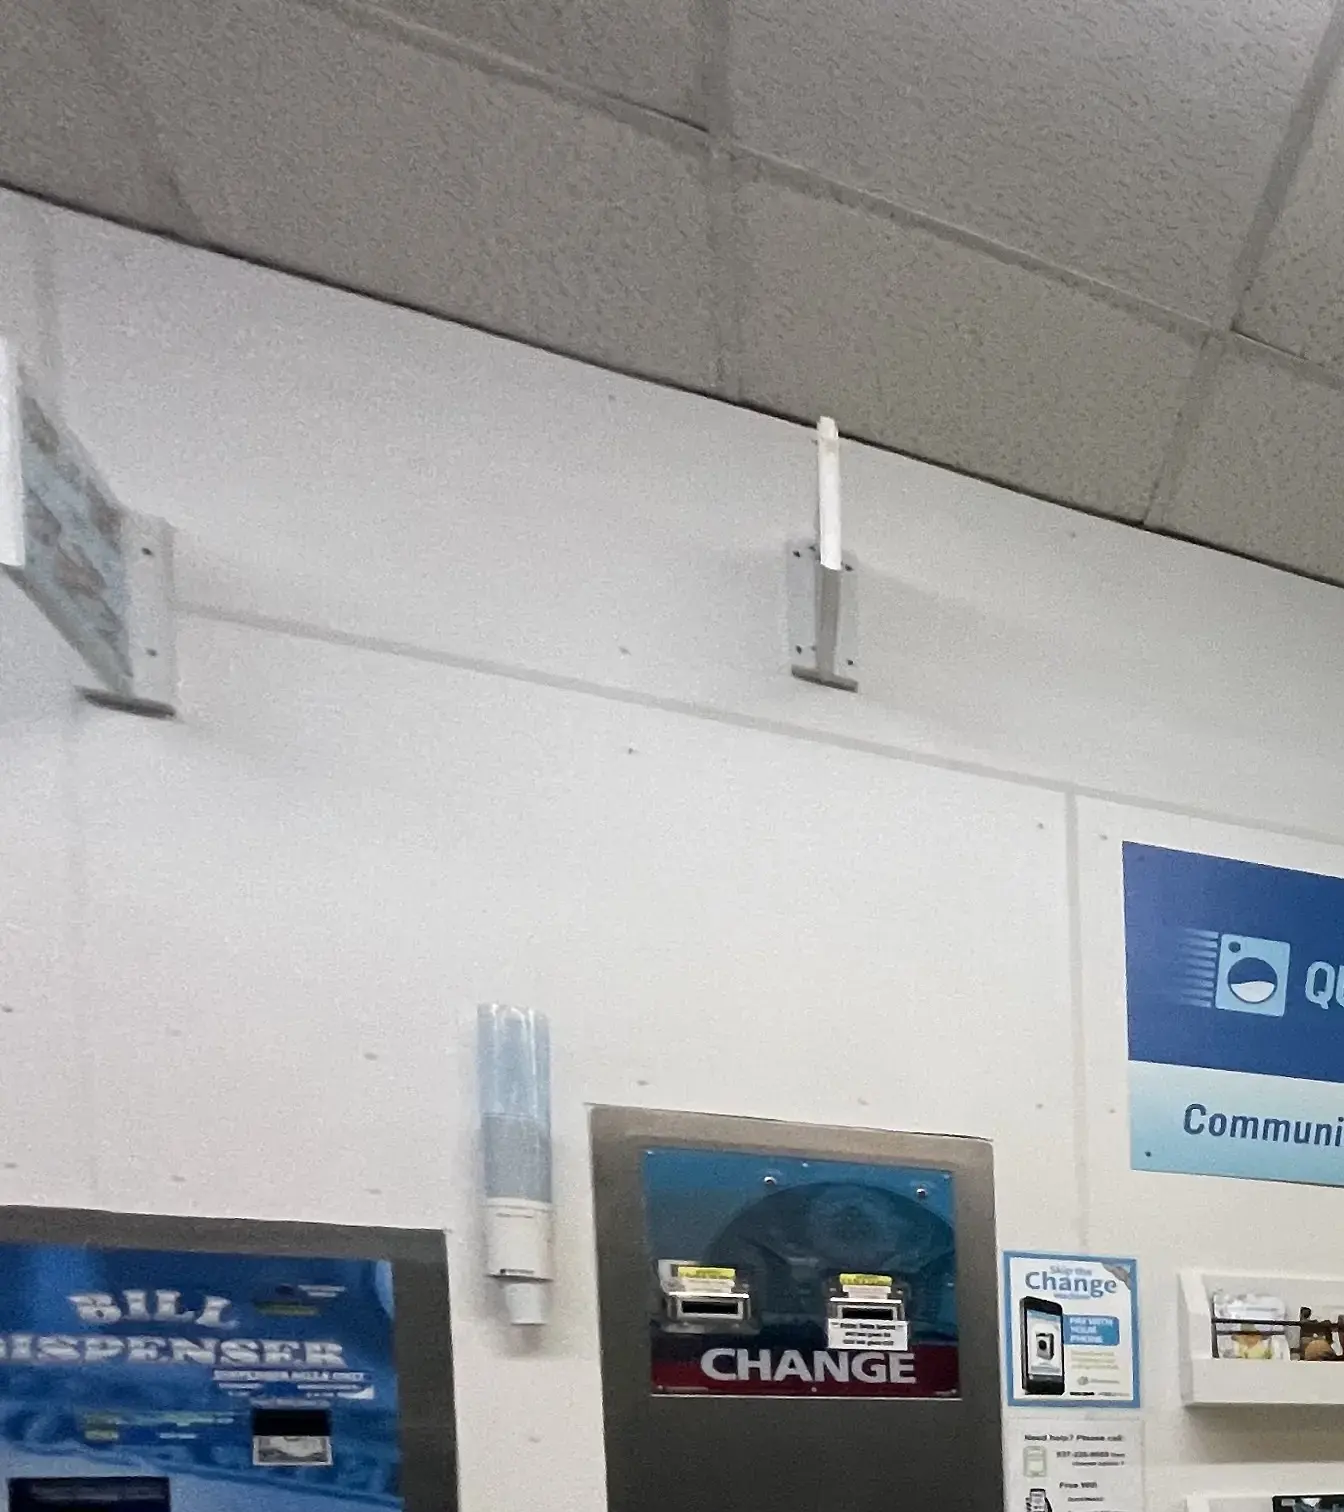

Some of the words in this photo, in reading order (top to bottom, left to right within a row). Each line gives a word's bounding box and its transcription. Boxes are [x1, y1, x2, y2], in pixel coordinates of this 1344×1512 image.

[1025, 1271, 1117, 1298] Change
[67, 1289, 240, 1329] BILL
[700, 1347, 917, 1384] CHANGE
